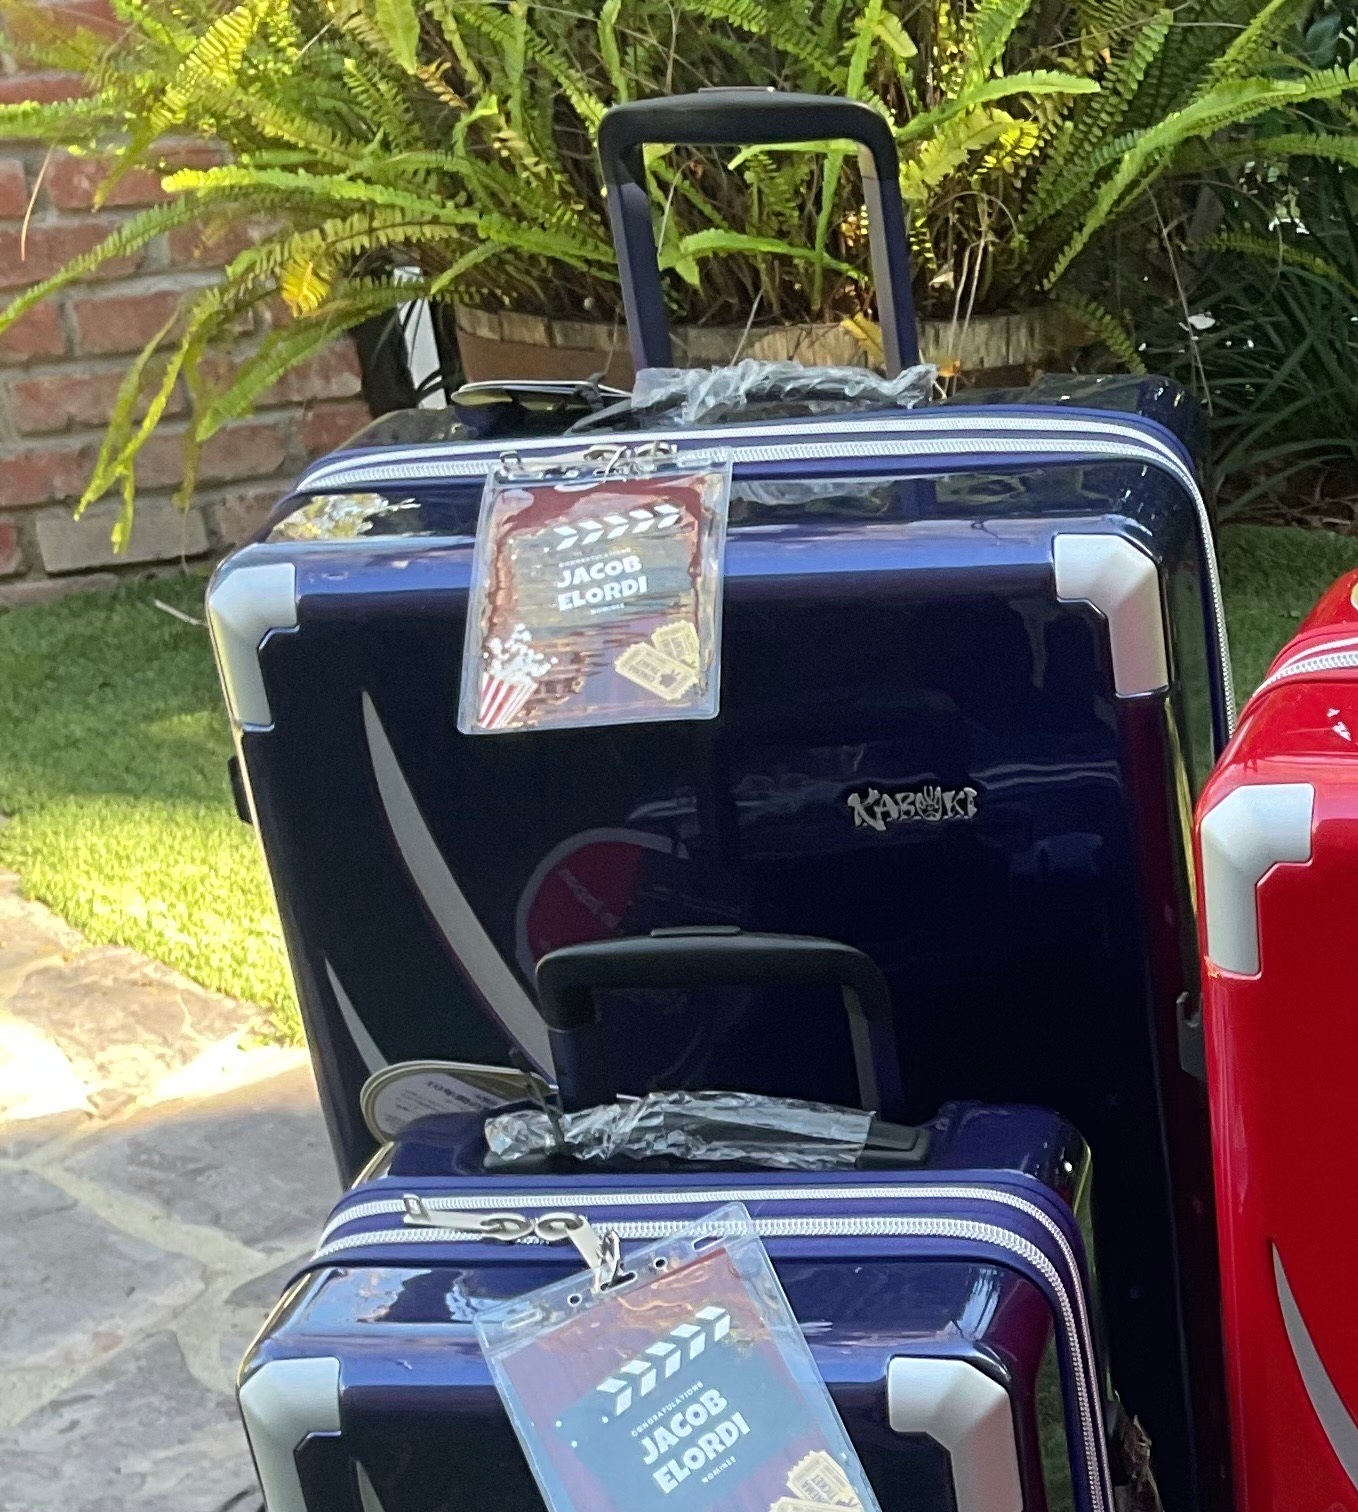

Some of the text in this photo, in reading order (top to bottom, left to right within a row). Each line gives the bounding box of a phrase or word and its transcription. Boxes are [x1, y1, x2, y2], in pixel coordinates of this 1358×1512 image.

[557, 555, 642, 588] JACOB
[557, 575, 648, 611] ELORDI
[641, 1389, 728, 1465] JACOB
[652, 1411, 751, 1494] ELORDI
